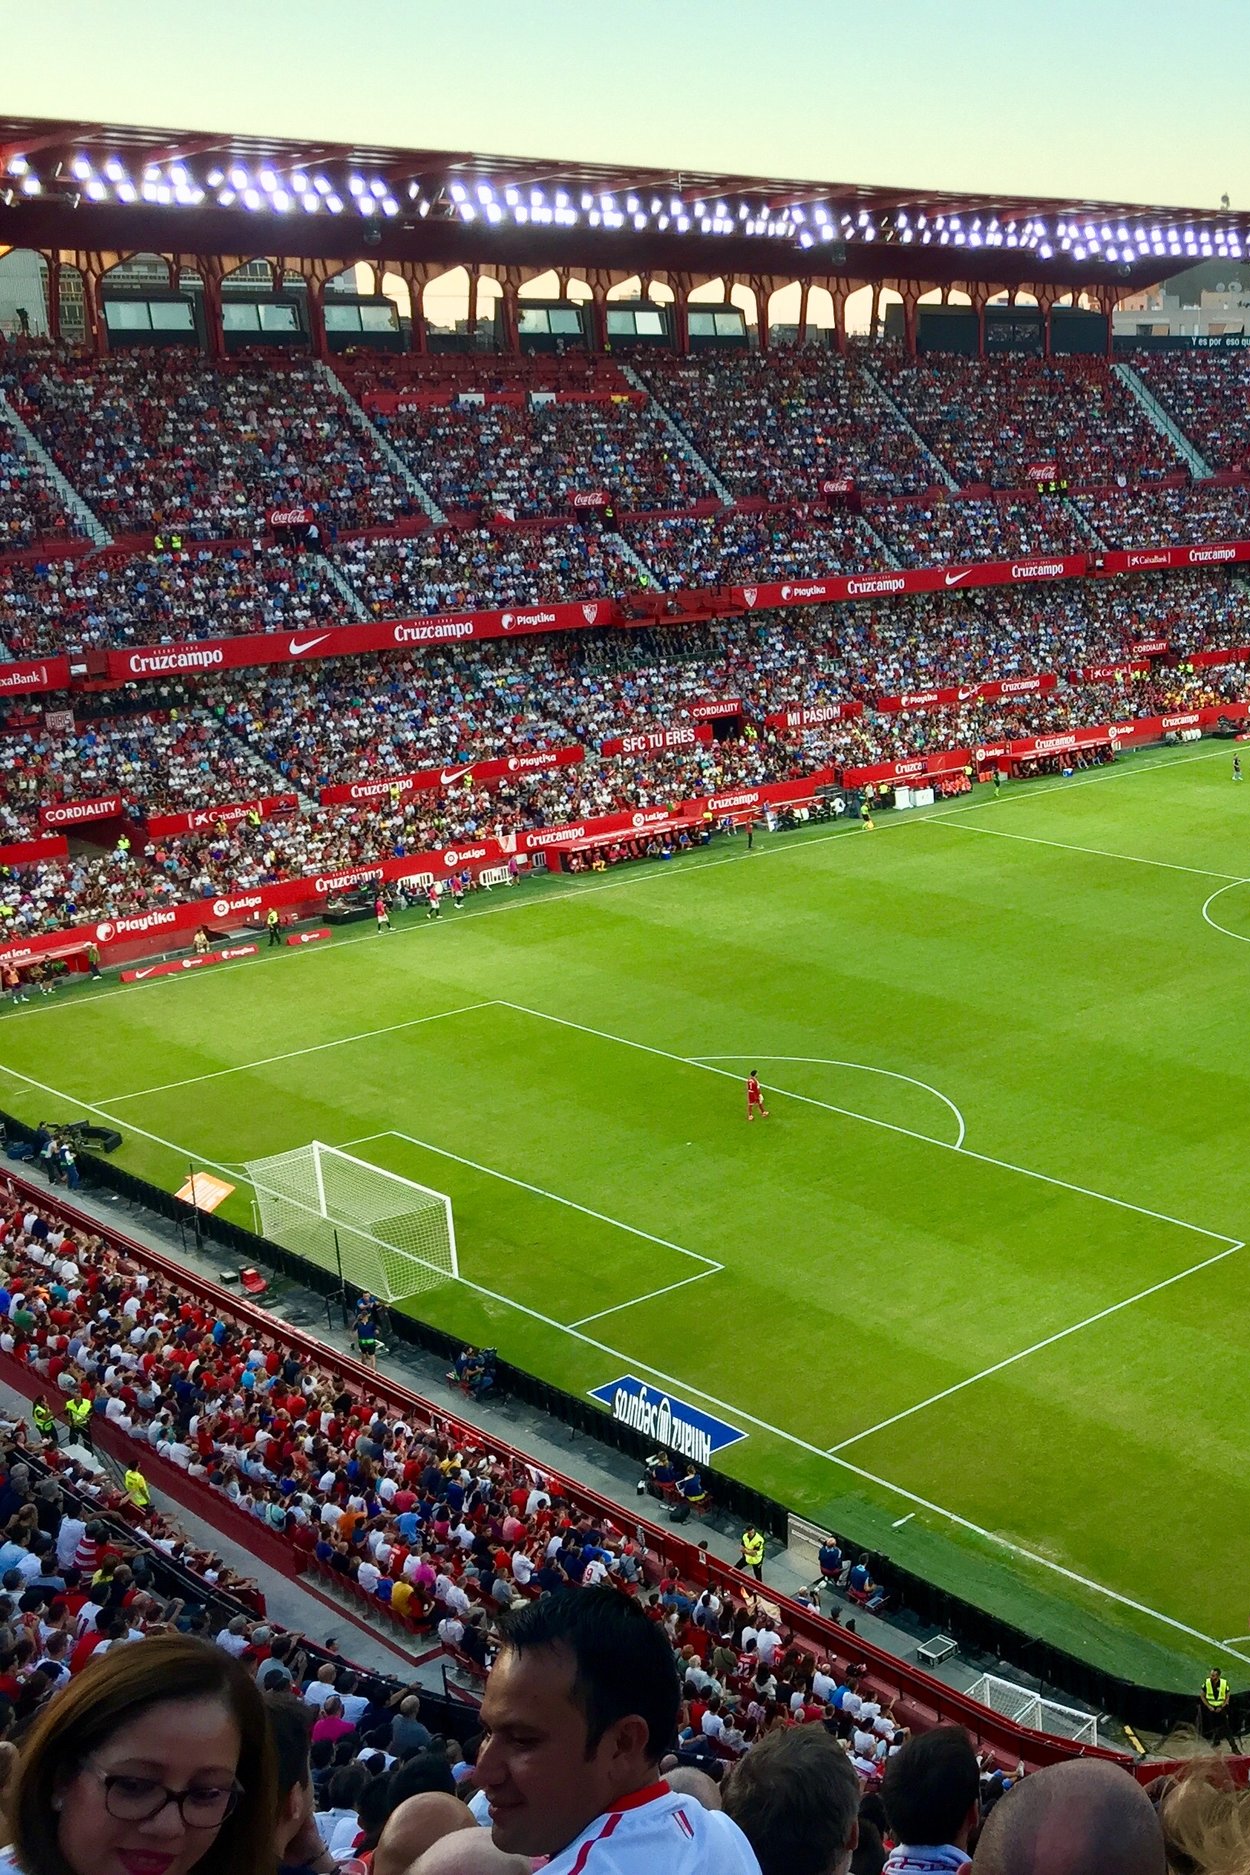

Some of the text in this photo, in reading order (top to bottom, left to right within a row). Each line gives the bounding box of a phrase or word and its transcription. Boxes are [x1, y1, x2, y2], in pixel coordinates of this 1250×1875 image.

[1191, 336, 1198, 346] Y
[1199, 338, 1208, 346] es
[1209, 338, 1222, 348] por
[1225, 338, 1240, 346] eso
[1189, 548, 1236, 562] Cruzcampo
[1012, 564, 1064, 579] Cruzcampo
[794, 585, 826, 598] Playtika
[848, 577, 905, 595] Cruzcampo
[517, 612, 556, 627] Playtika
[394, 621, 474, 642] Cruzcampo
[1132, 643, 1168, 654] CORDIALITY
[129, 649, 223, 673] Cruzcampo
[1001, 679, 1041, 693] Cruzcampo
[910, 693, 938, 705] Playtika
[693, 702, 738, 718] CORDIALITY
[787, 713, 801, 727] MI
[1162, 714, 1200, 728] Cruzcampo
[1117, 726, 1135, 735] LaLiga
[622, 728, 696, 753] SFC TU ERES
[1035, 734, 1076, 750] Cruzcampo
[520, 751, 557, 769] Playtika
[986, 748, 1005, 758] LaLiga
[708, 792, 760, 811] Cruzcampo
[45, 800, 116, 822] CORDIALITY
[644, 810, 669, 822] LaLiga
[526, 825, 586, 849] Cruzcampo
[458, 847, 487, 862] LaLiga
[230, 895, 262, 910] LaLiga
[116, 911, 176, 934] Playtika
[612, 1386, 712, 1467] Allianz Seguros
